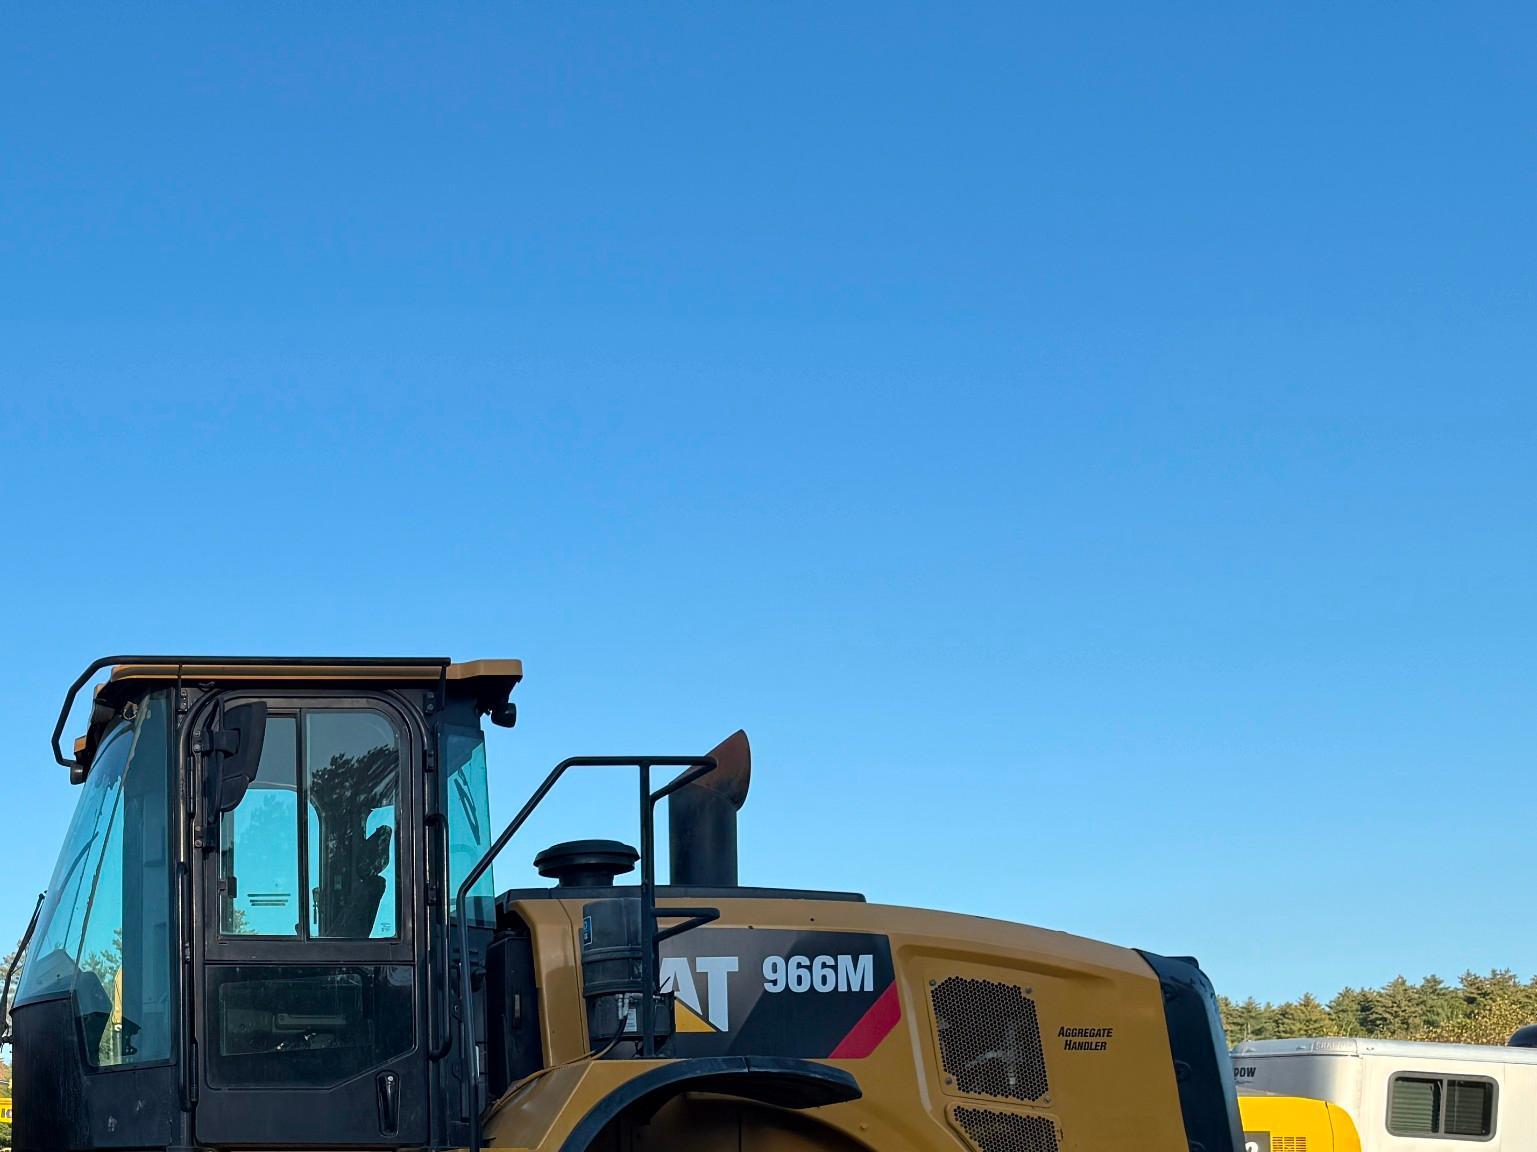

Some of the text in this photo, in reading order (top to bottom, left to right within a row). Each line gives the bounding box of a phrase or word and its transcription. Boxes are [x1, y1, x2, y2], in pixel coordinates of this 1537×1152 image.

[658, 954, 874, 1032] AT 966M
[1057, 1026, 1113, 1038] AGGREGATE
[1064, 1039, 1107, 1051] HANDLER
